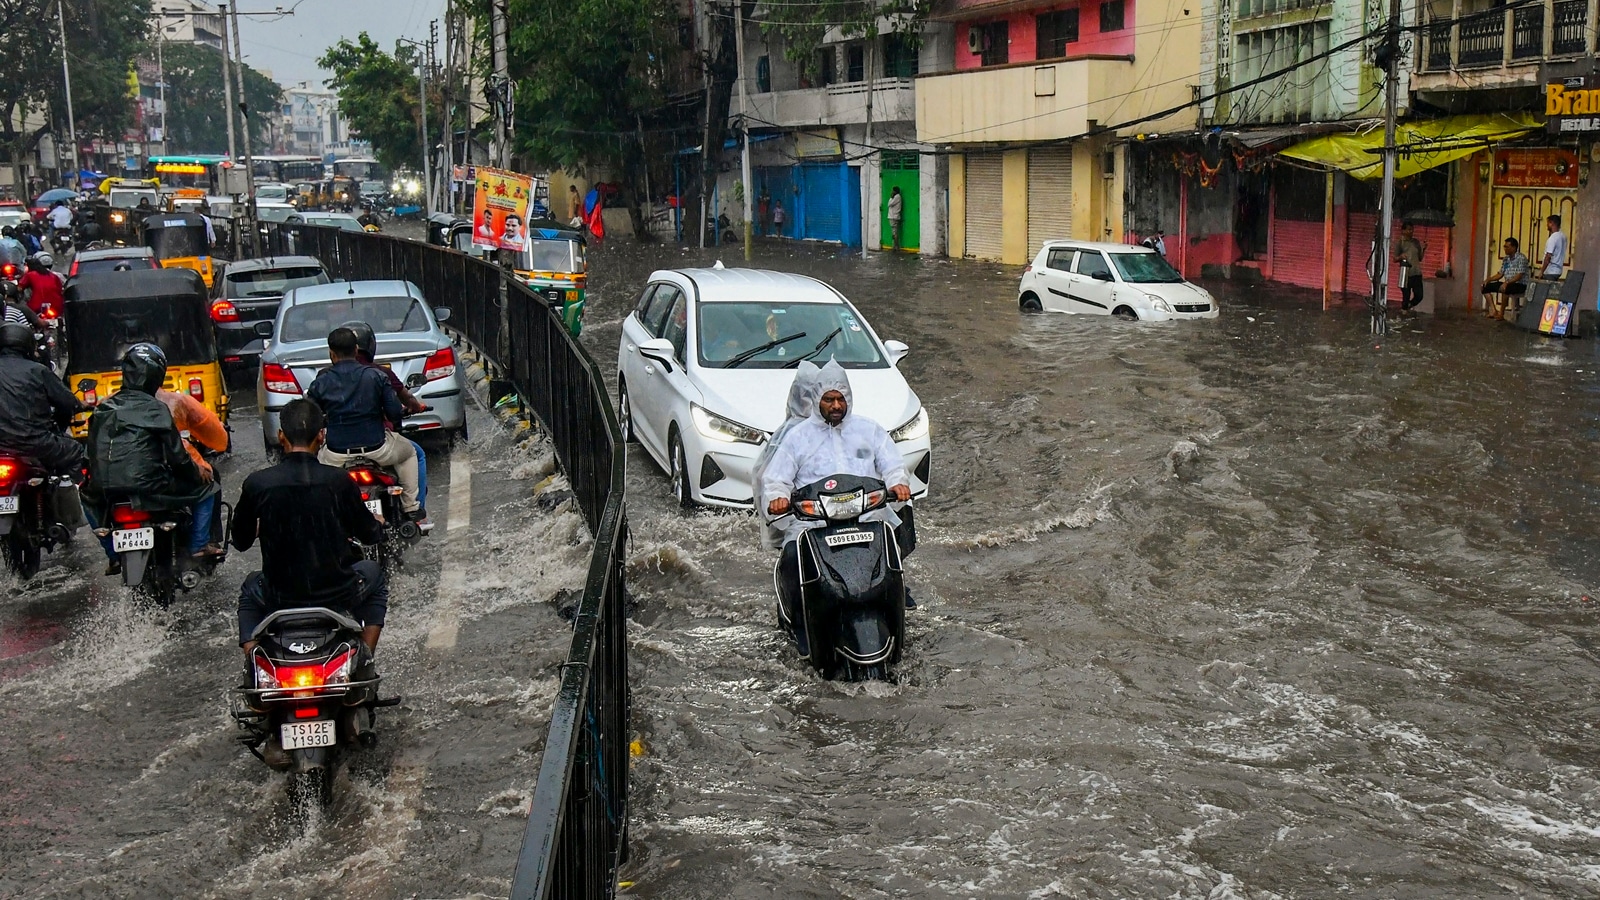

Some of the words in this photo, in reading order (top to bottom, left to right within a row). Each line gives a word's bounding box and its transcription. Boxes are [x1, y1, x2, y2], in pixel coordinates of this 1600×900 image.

[123, 532, 133, 540] AP
[135, 531, 143, 539] 11
[117, 541, 127, 550] AP
[128, 539, 149, 548] 6446
[291, 723, 328, 736] TS12E
[292, 734, 329, 748] Y1930
